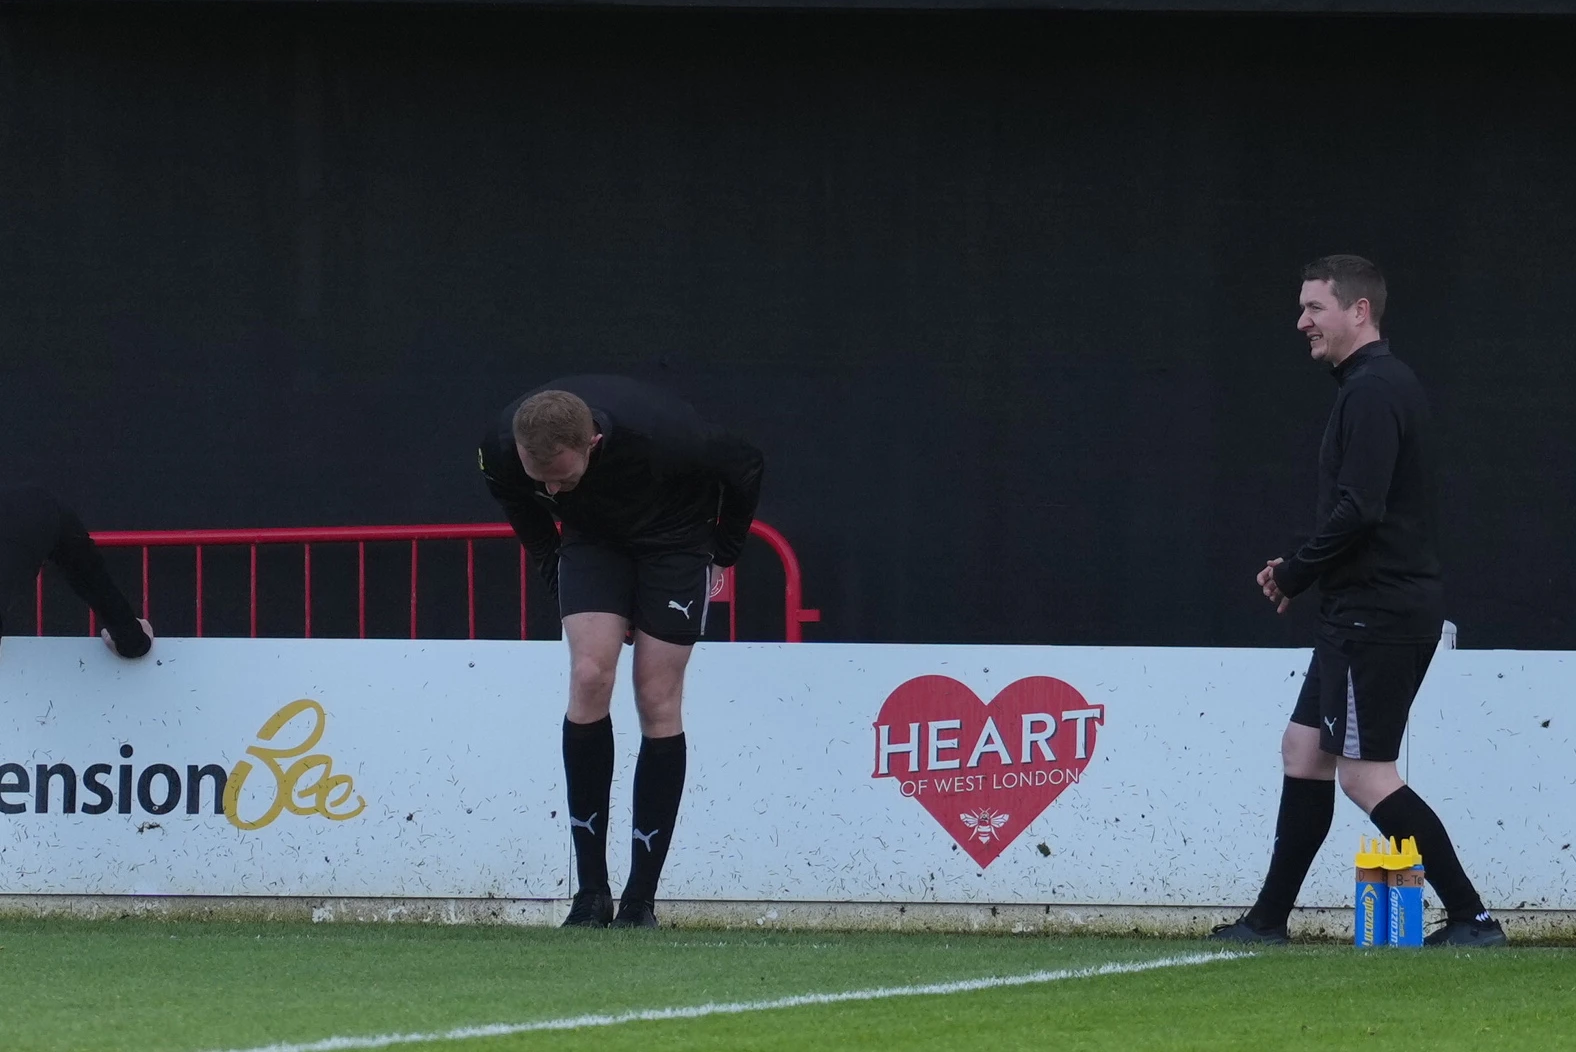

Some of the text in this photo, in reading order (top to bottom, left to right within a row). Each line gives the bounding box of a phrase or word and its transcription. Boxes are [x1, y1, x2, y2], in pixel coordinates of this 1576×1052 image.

[877, 708, 1101, 775] HEART
[899, 767, 1080, 797] OF WEST LONDON
